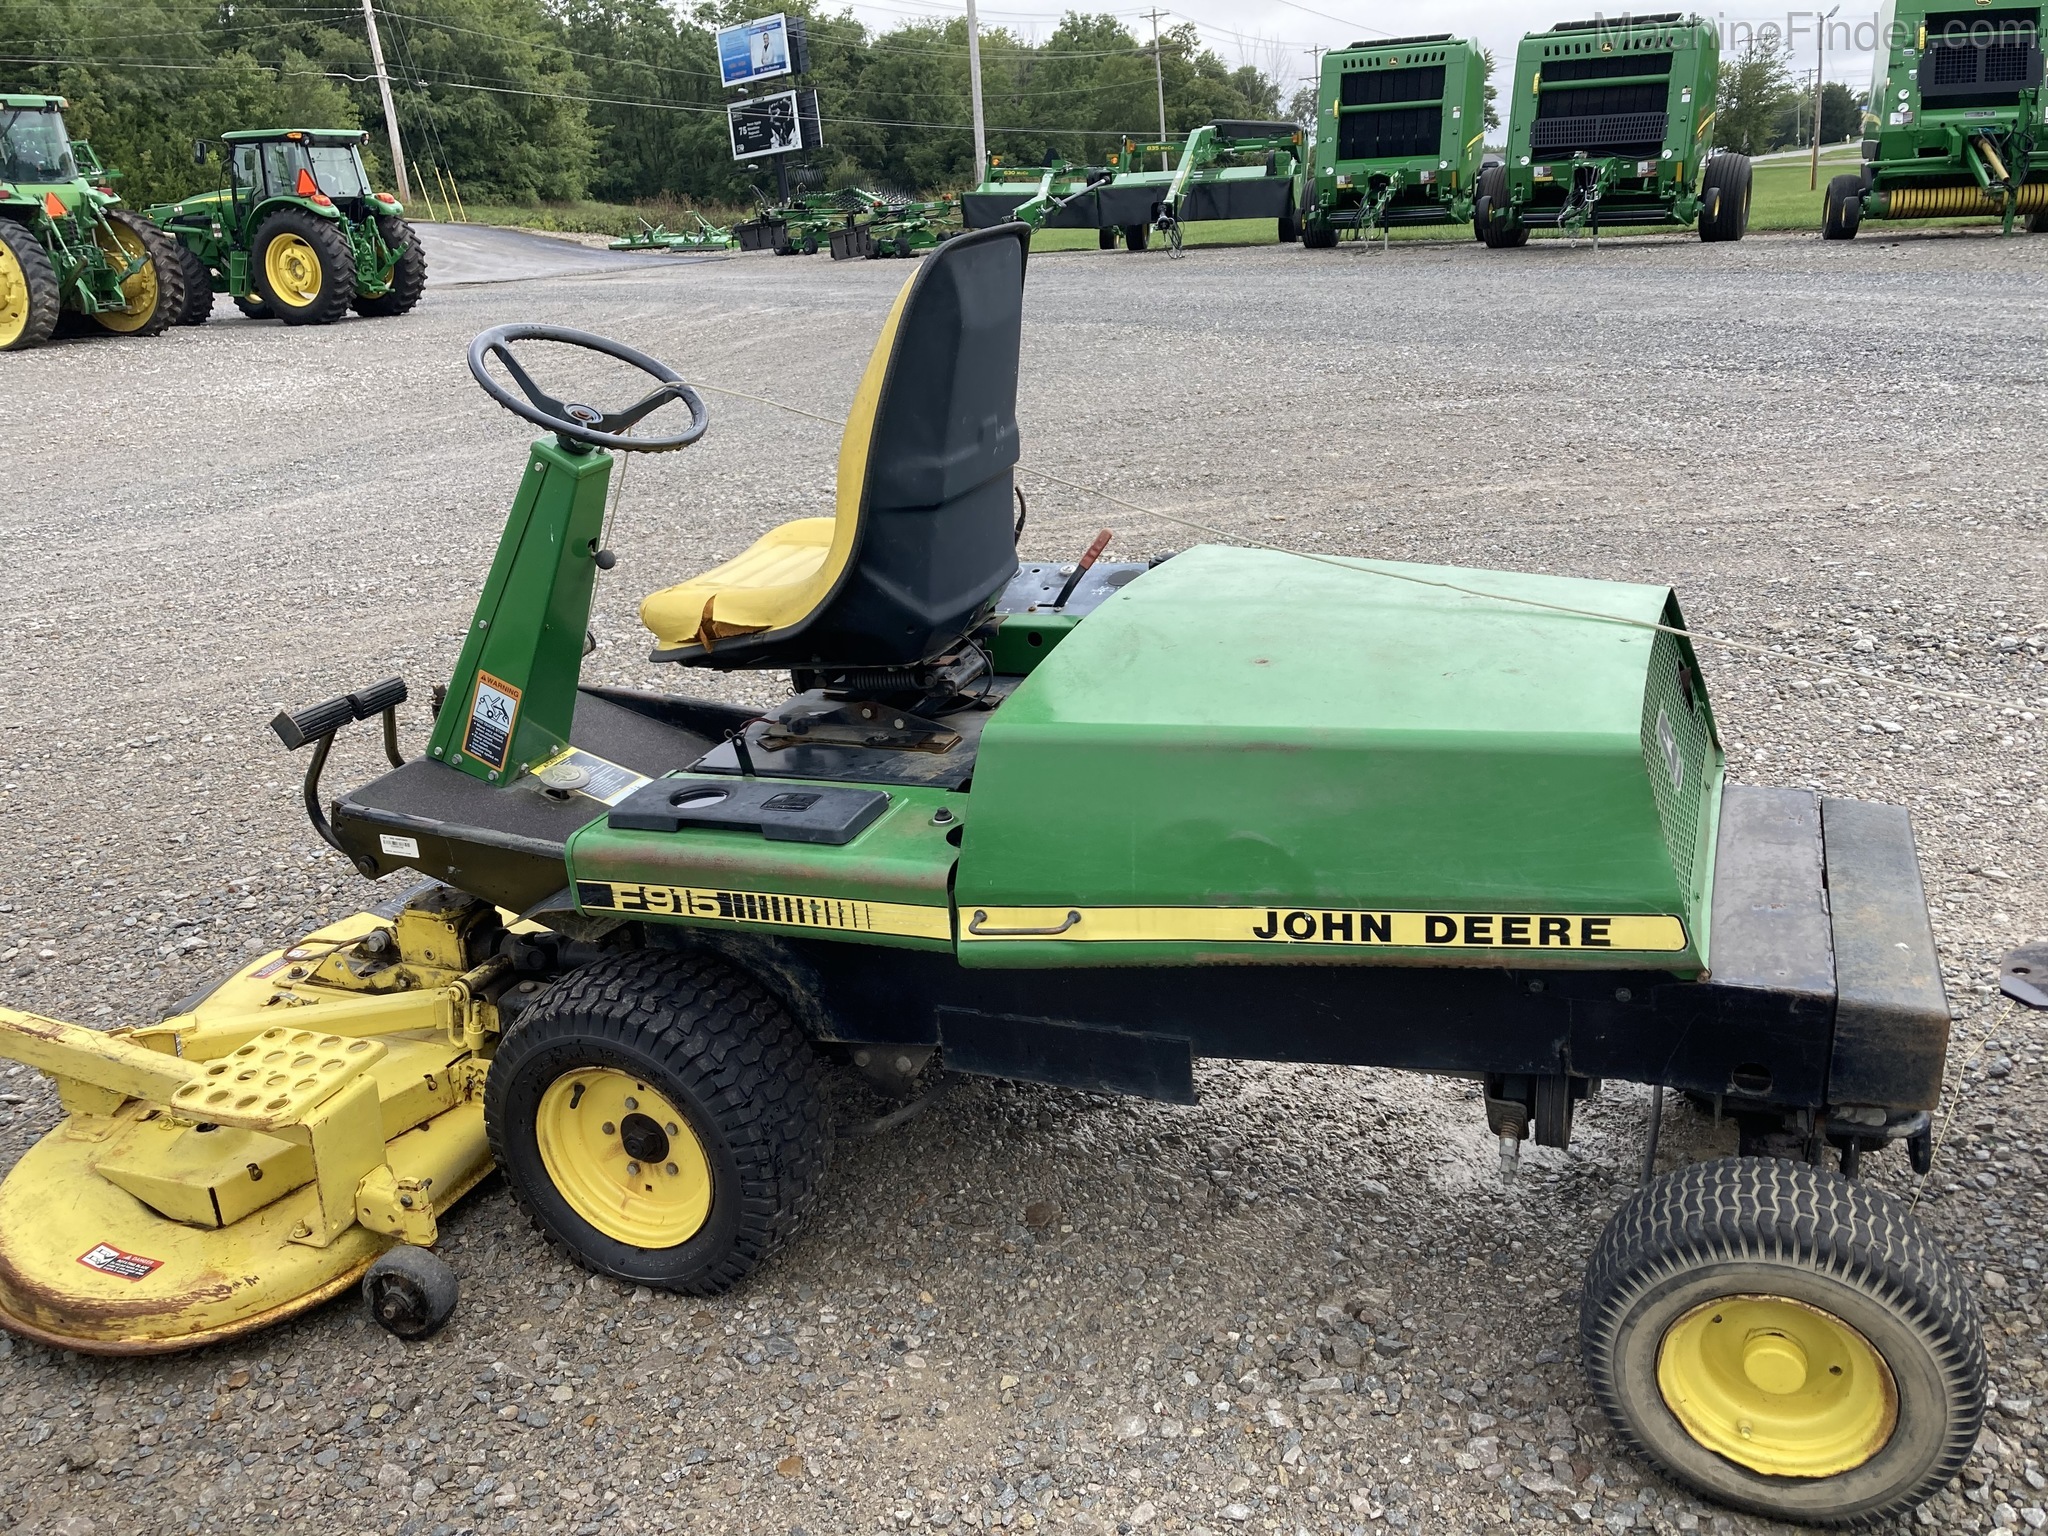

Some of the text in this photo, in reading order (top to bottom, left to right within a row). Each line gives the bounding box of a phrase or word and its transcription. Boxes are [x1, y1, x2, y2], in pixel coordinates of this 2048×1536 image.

[487, 677, 519, 698] WARNING
[610, 882, 721, 917] F915
[1252, 911, 1612, 947] JOHN DEERE
[131, 1256, 155, 1265] DANGER
